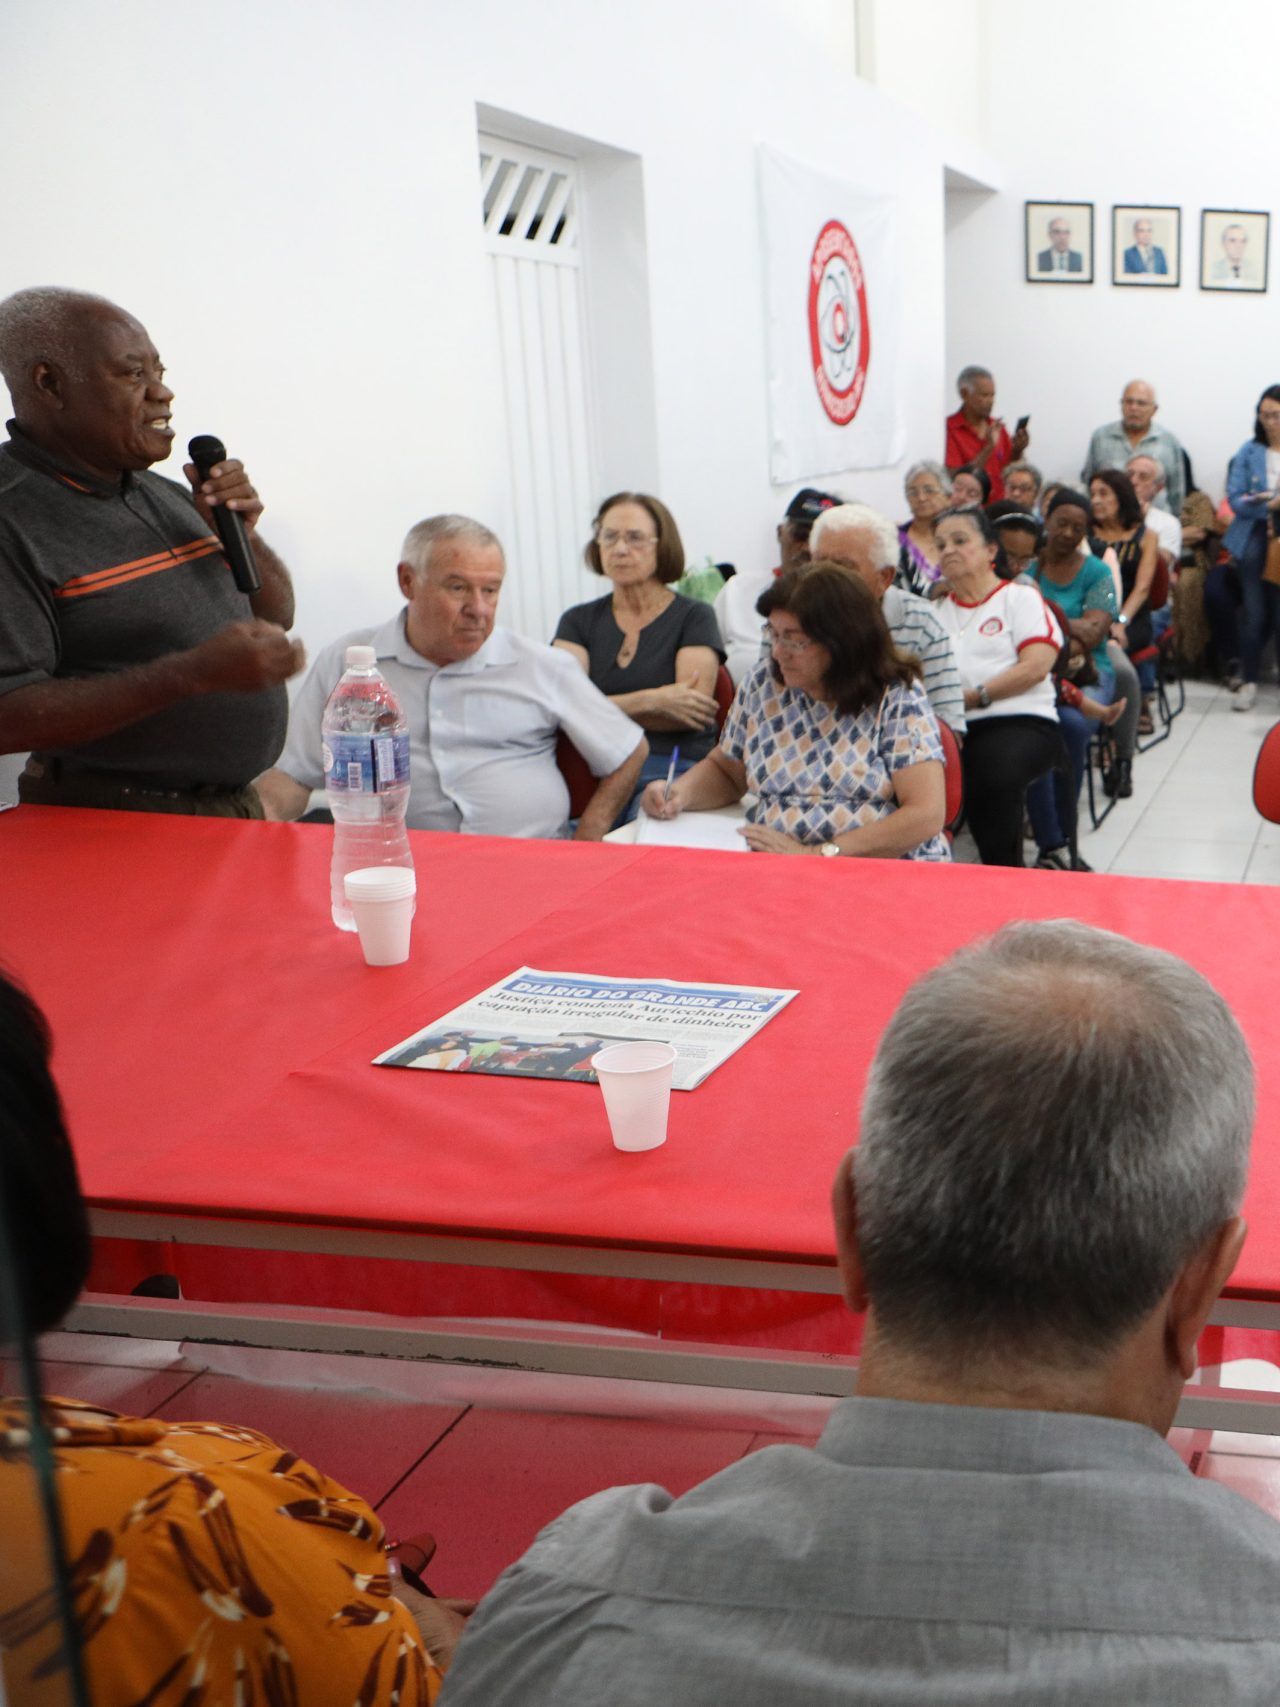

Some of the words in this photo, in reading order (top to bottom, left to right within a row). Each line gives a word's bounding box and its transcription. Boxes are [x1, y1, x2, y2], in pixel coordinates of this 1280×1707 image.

[489, 992, 554, 1005] Justiça
[557, 999, 634, 1009] condena
[727, 1012, 762, 1021] por
[591, 989, 628, 1000] DO
[629, 990, 722, 1007] GRANDE
[719, 999, 769, 1012] ABC
[478, 1001, 558, 1015] captação
[562, 1007, 645, 1019] irregular
[646, 1014, 670, 1023] de
[672, 1016, 752, 1030] dinheiro
